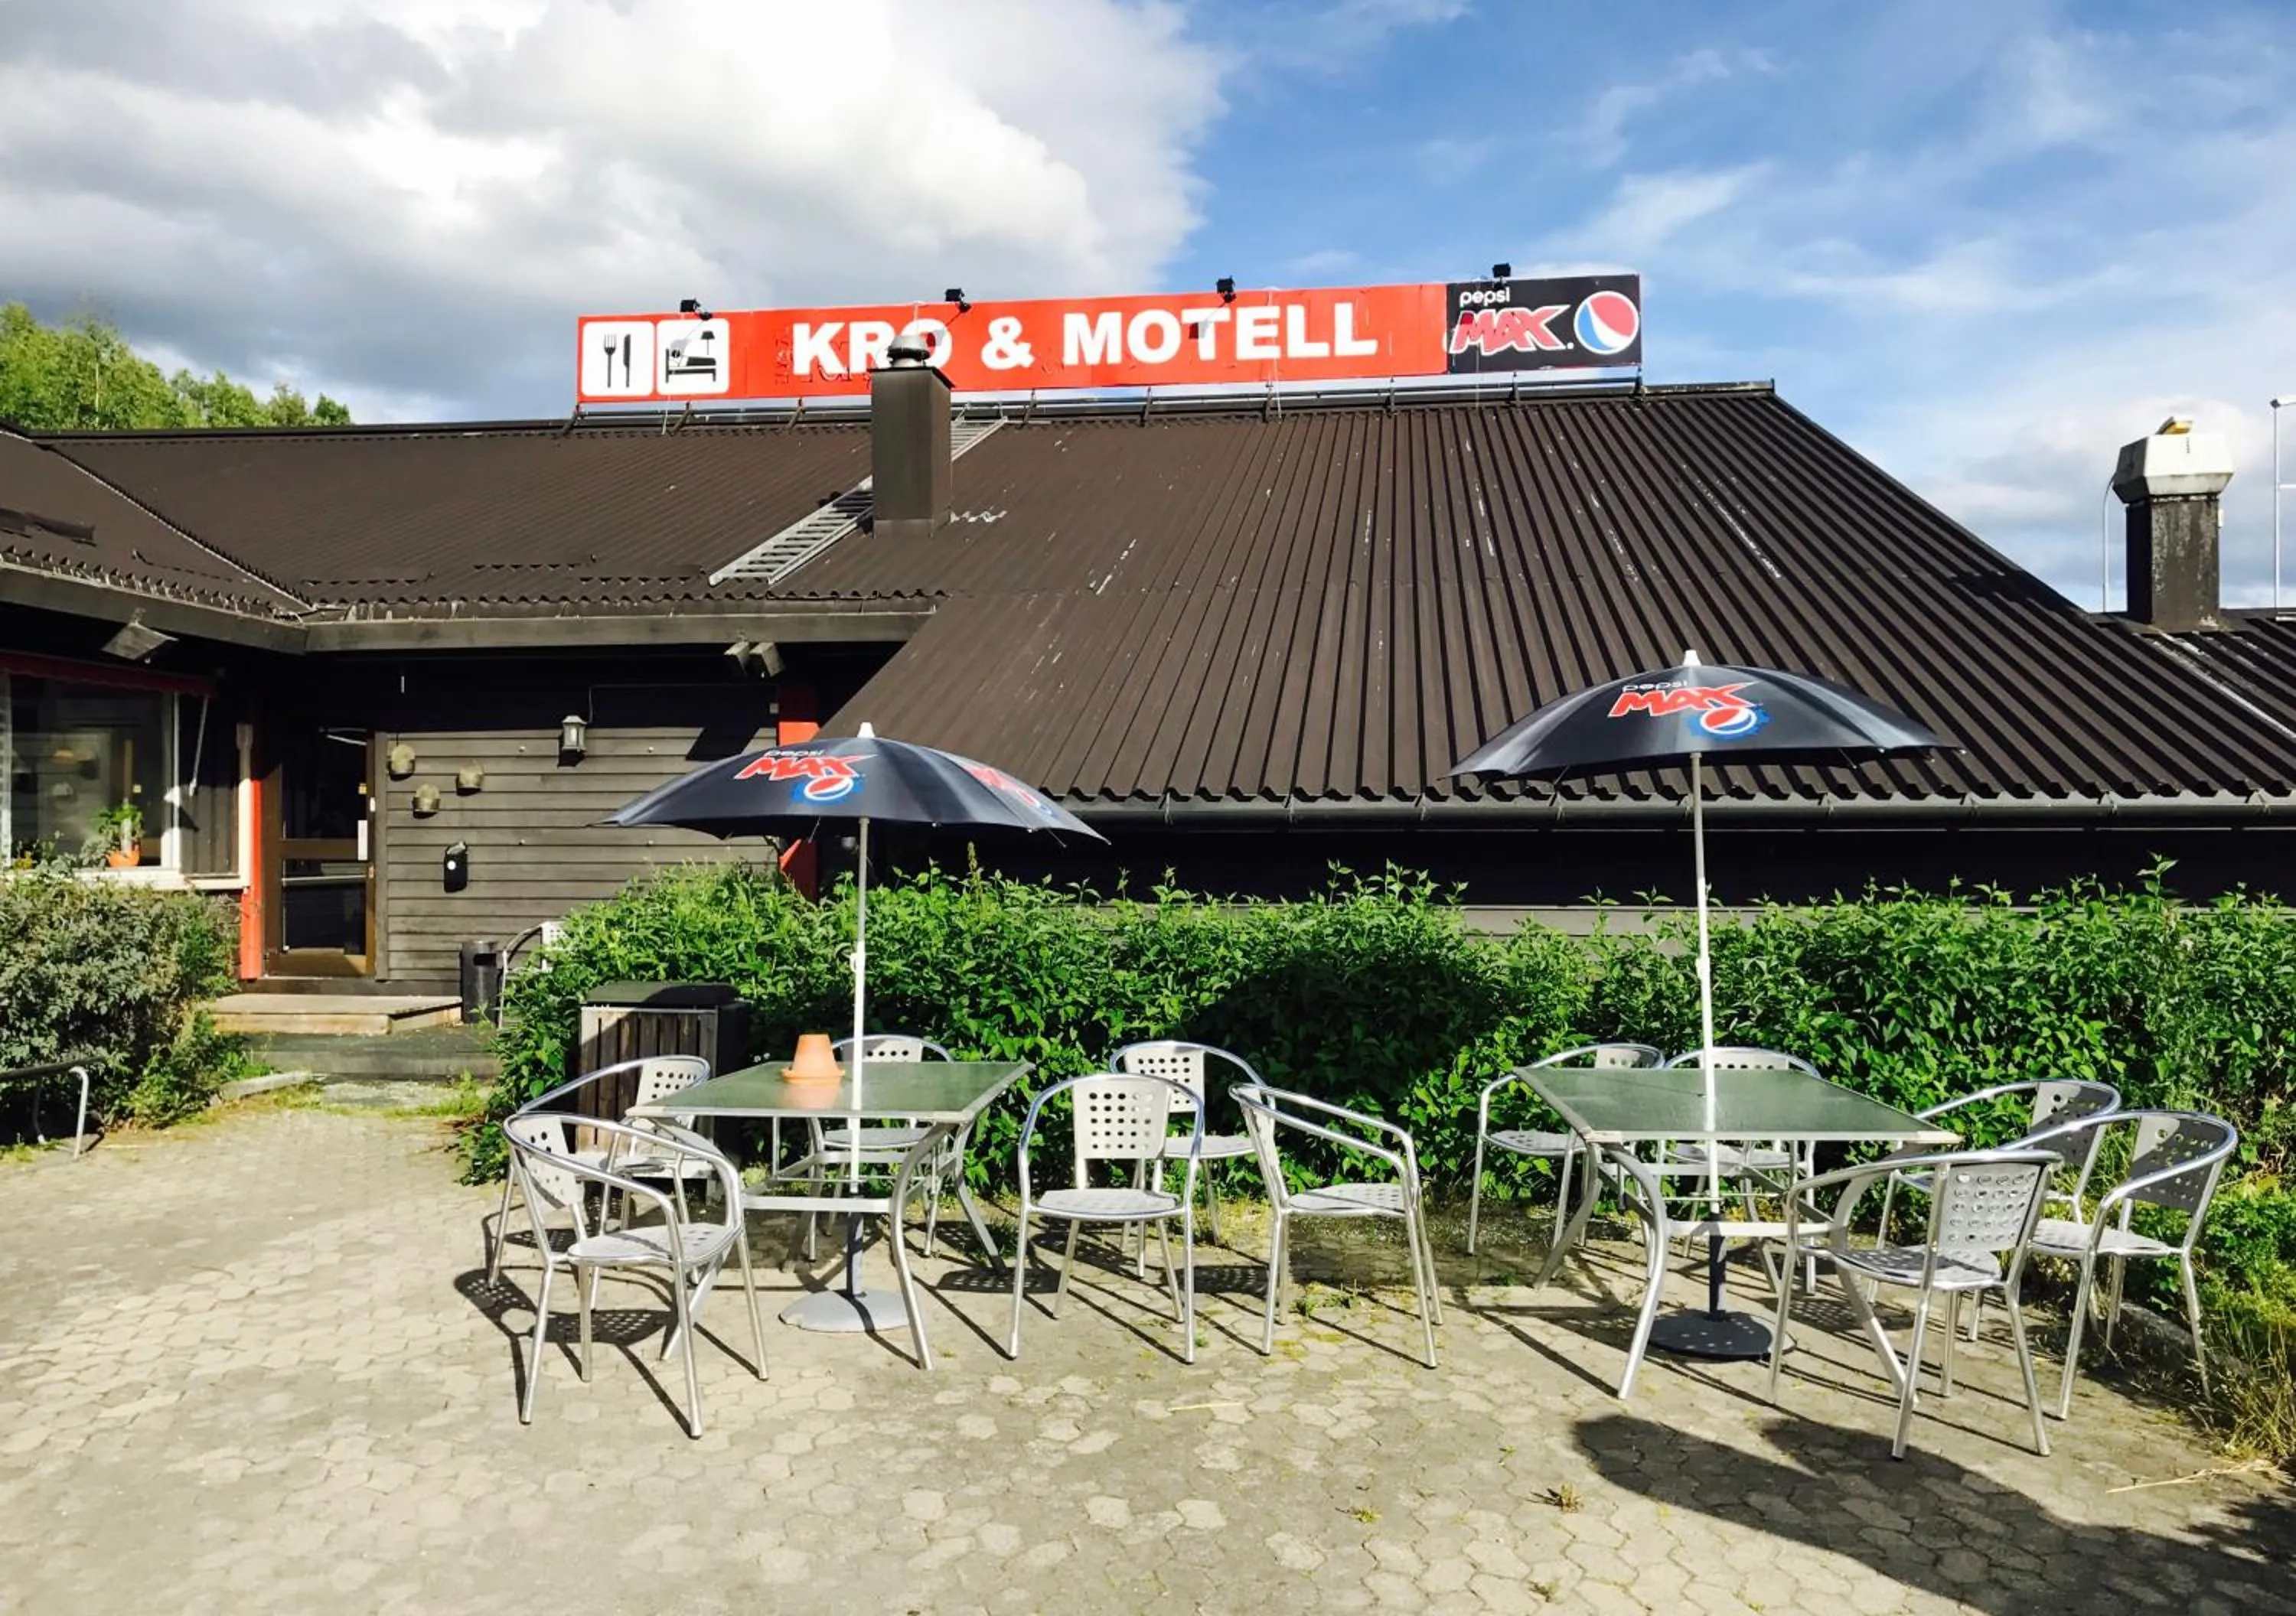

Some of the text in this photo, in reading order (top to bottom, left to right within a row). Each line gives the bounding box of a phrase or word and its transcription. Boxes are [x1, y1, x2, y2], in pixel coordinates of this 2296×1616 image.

[1459, 286, 1511, 307] pepsi
[792, 301, 1378, 376] KRO & MOTELL
[1622, 679, 1688, 692] pepsi
